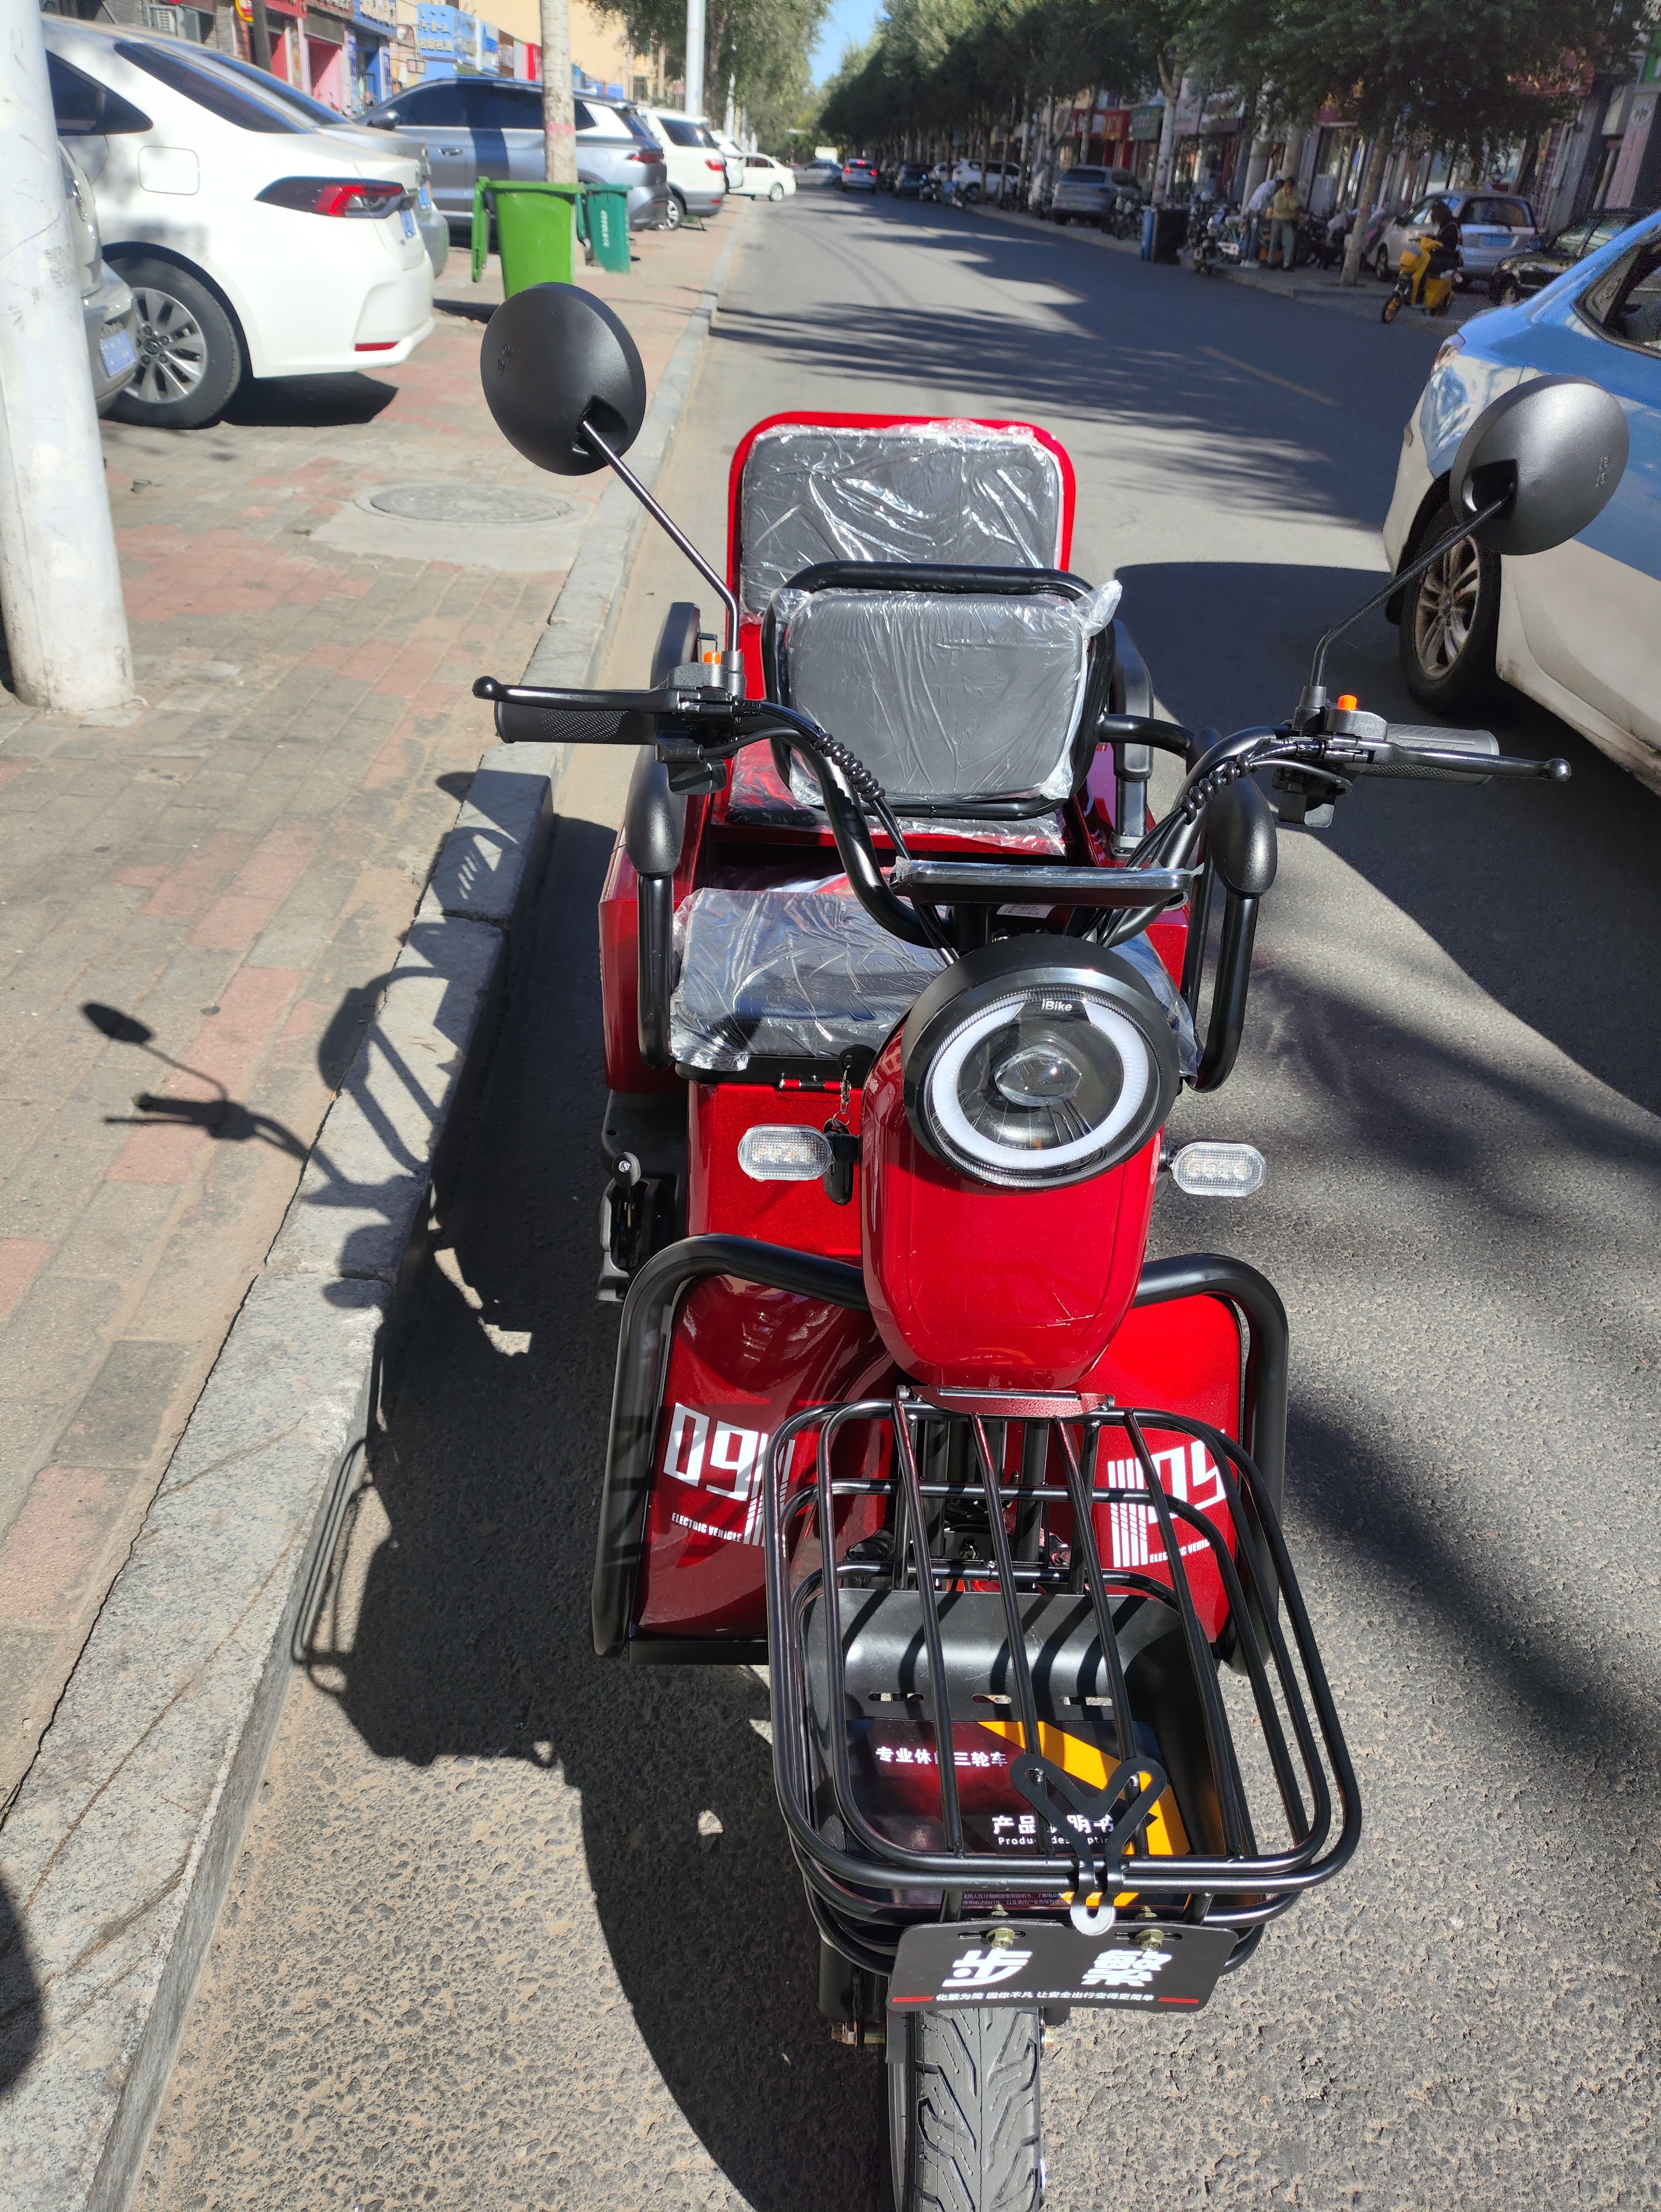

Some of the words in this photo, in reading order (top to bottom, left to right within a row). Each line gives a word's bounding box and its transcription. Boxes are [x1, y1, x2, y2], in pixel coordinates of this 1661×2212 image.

[1041, 998, 1072, 1011] iBike
[664, 1402, 758, 1501] 09
[671, 1512, 708, 1534] ELECTRIC
[708, 1526, 742, 1542] VEHICLE
[1150, 1546, 1186, 1563] ELECC
[1187, 1539, 1210, 1553] VEHIC
[875, 1746, 1008, 1767] 专业休三轮车
[992, 1815, 1114, 1834] 产品明书
[998, 1836, 1037, 1845] Produ
[1052, 1835, 1109, 1845] despti
[936, 1992, 984, 2002] 化繁为简
[1037, 1991, 1154, 2001] 让安全出行变得更简单
